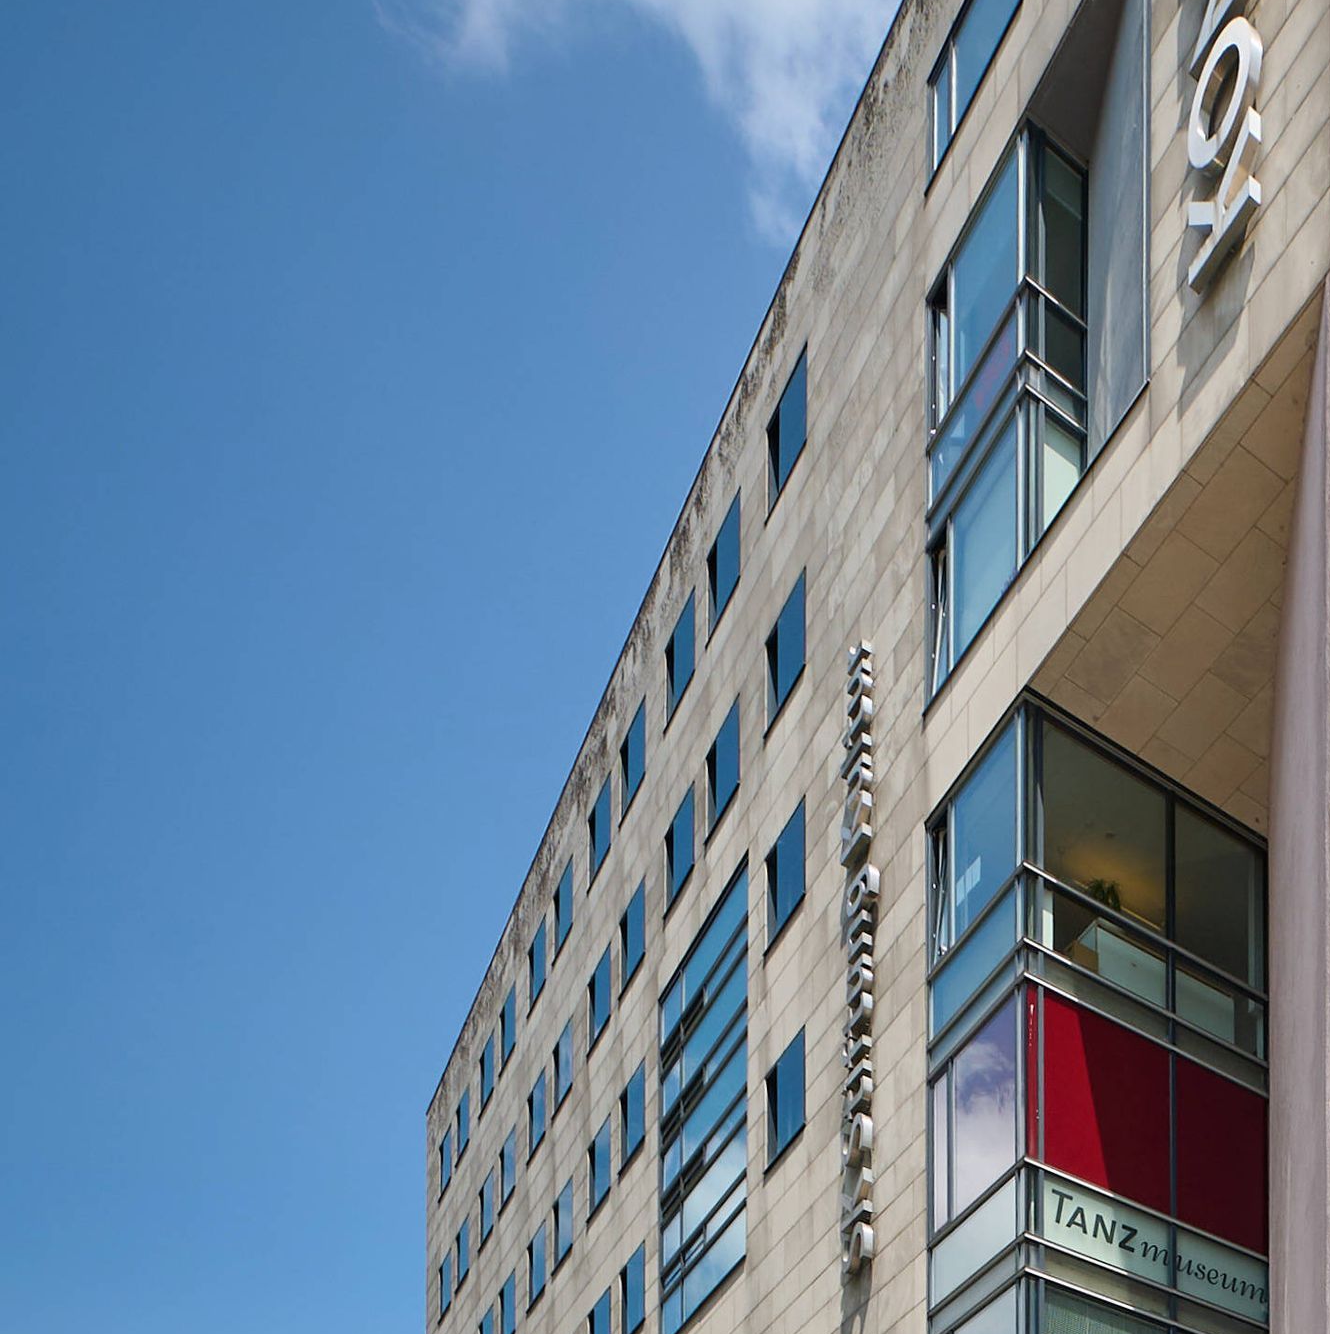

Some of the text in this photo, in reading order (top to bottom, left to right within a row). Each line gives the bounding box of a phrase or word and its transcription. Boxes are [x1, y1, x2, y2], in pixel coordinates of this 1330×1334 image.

[840, 639, 874, 867] Kultur
[840, 864, 881, 1167] Stiftung
[1051, 1188, 1269, 1305] TANZmuseum
